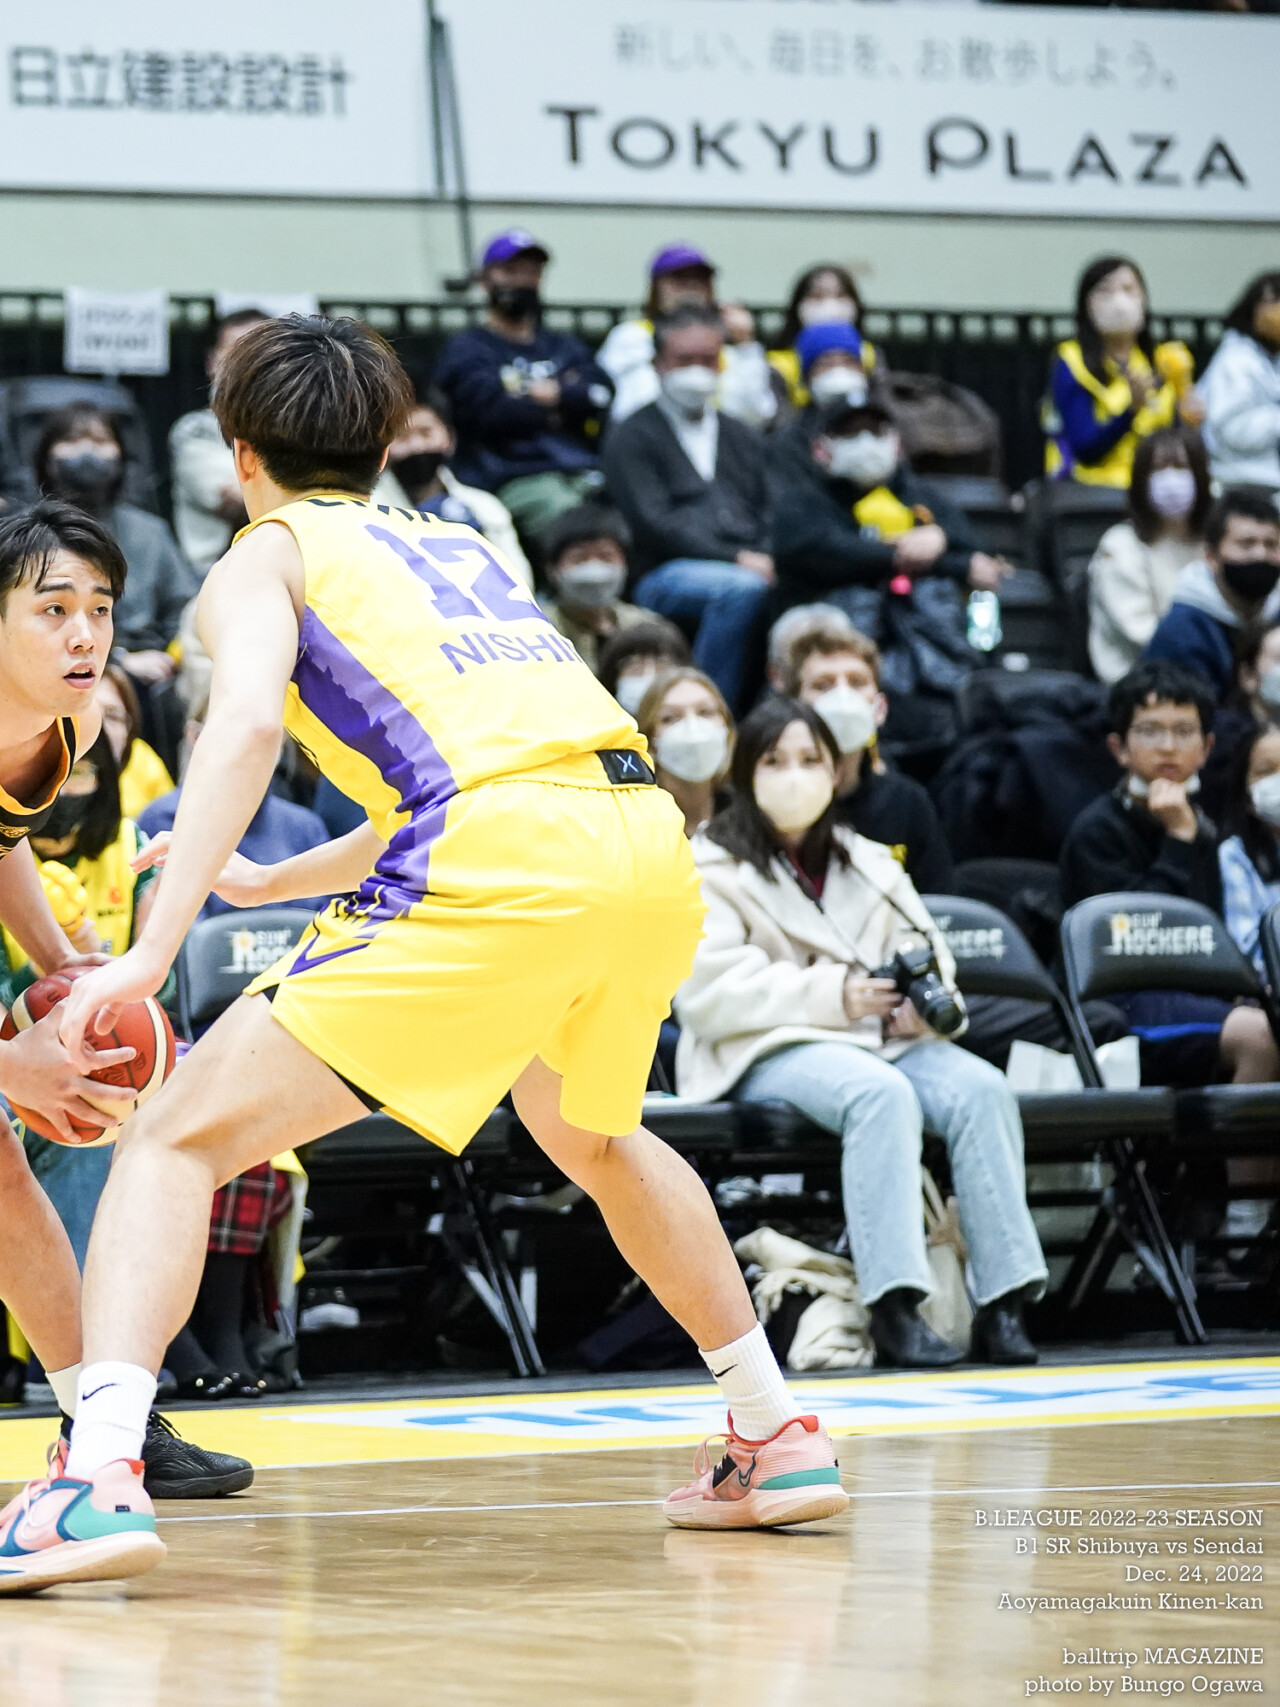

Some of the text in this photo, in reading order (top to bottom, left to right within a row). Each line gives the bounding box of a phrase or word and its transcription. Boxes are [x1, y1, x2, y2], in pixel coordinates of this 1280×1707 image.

[10, 44, 352, 117] 日立建設設計
[546, 105, 1249, 187] TOKYU PLAZA
[364, 523, 552, 622] 12
[439, 632, 582, 675] NISHI
